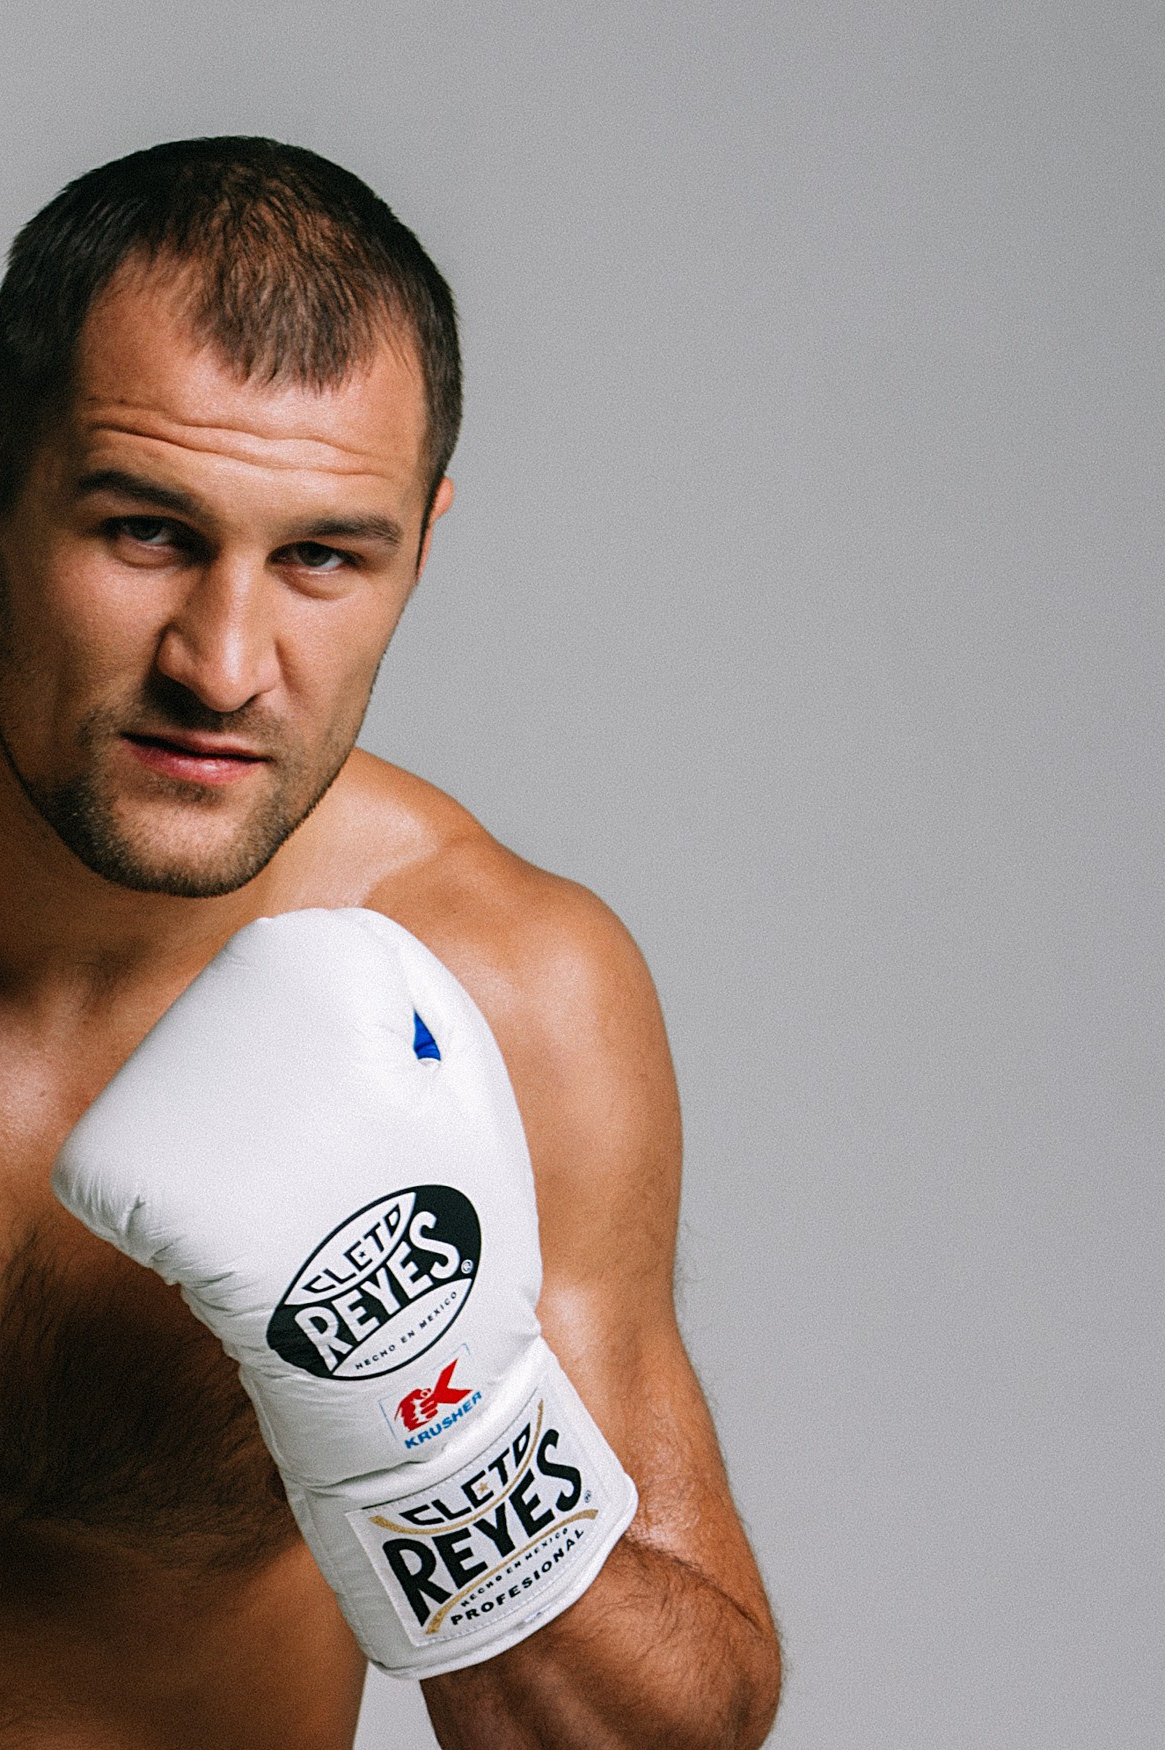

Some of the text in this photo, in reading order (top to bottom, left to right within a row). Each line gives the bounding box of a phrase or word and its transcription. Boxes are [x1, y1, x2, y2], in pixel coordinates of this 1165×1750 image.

[294, 1210, 461, 1372] REYES
[355, 1291, 457, 1370] HECHO EN MEXICO
[404, 1391, 482, 1449] KRUSHER
[382, 1428, 582, 1627] REYES
[460, 1527, 568, 1607] HECHO EN MEXICO
[450, 1528, 584, 1626] PROFESIONAL
